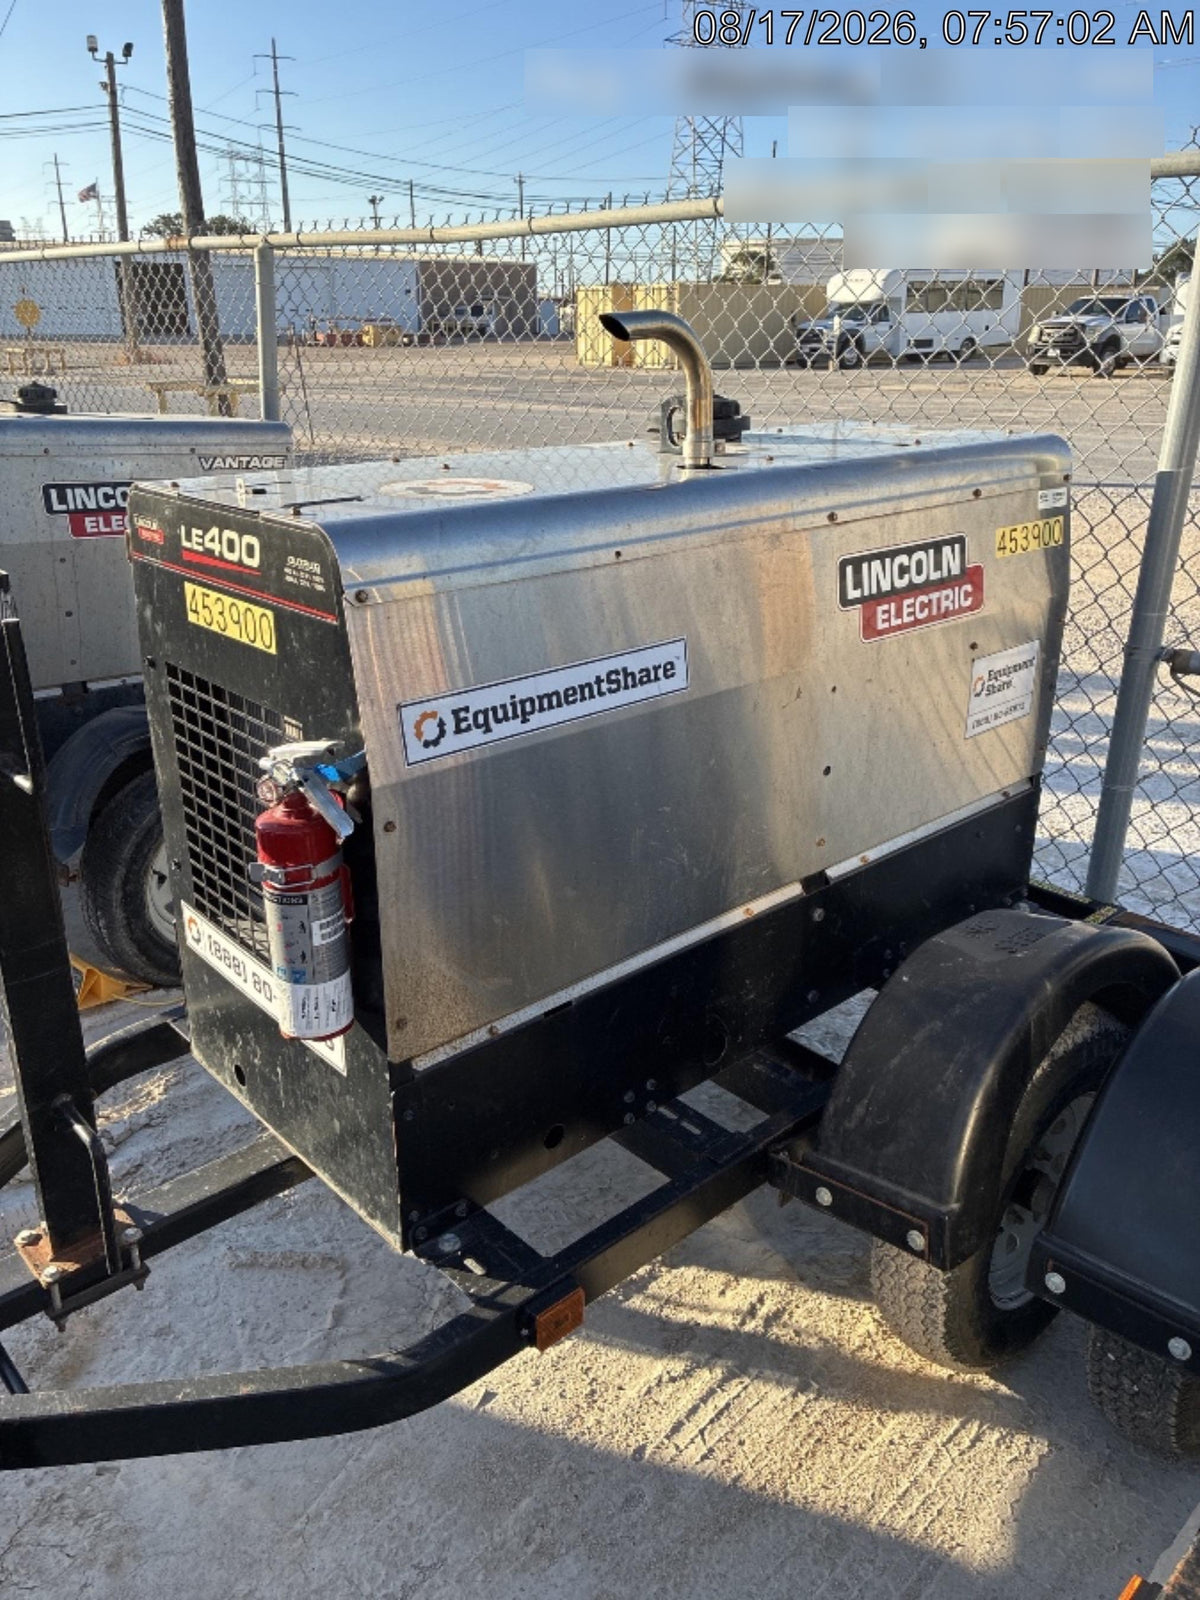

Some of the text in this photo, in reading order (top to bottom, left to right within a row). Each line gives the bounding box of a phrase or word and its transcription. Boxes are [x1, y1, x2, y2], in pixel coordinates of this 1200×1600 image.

[201, 456, 284, 469] VANTAGE
[49, 486, 128, 511] LINCO
[84, 516, 129, 533] ELE
[997, 518, 1063, 555] 453900
[181, 525, 260, 568] LE400
[845, 543, 961, 600] LINCOLN
[189, 588, 273, 650] 453900
[875, 583, 973, 630] ELECTRIC
[451, 659, 676, 735] EquipmentShare
